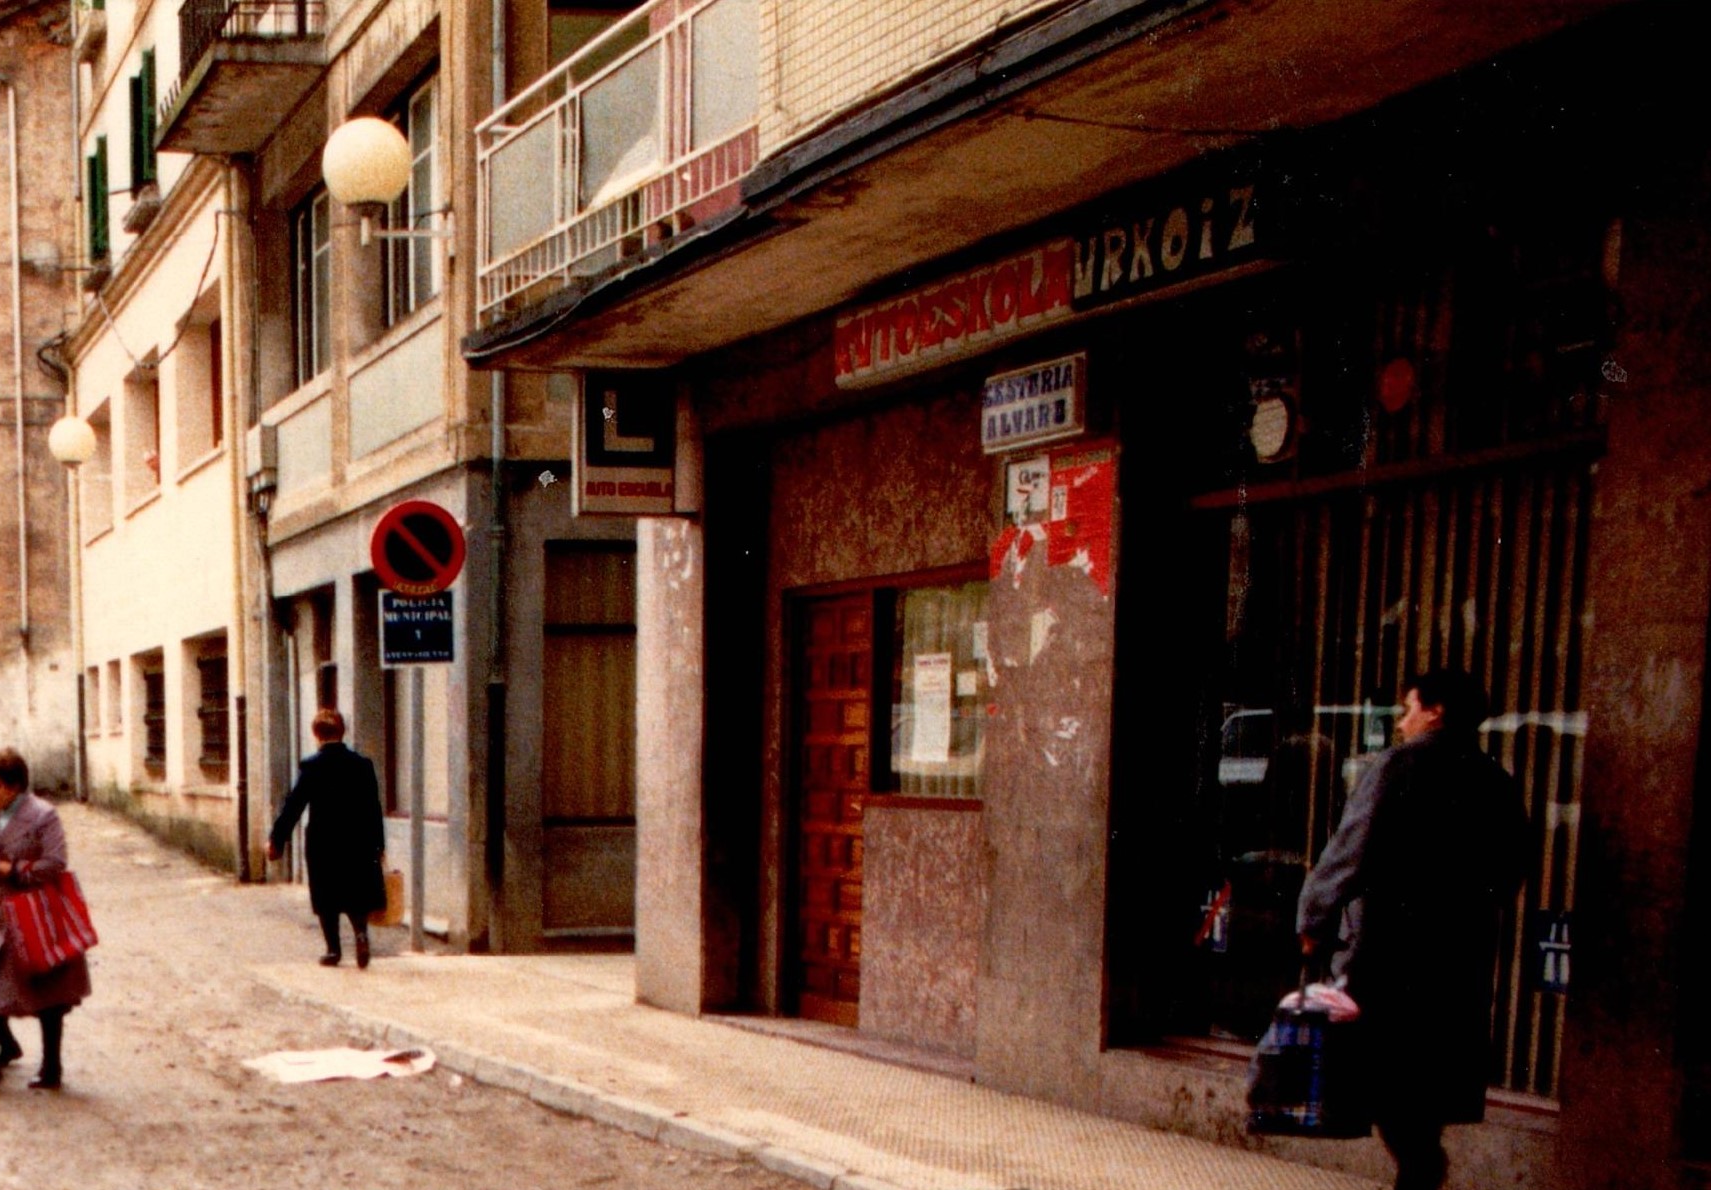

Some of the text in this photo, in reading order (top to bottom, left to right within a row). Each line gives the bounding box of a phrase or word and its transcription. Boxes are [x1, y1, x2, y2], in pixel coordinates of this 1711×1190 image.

[986, 400, 1066, 440] ALVARO
[586, 481, 673, 497] AUTO ESCUELA
[392, 597, 445, 608] POLICIA
[384, 610, 451, 622] MUNICIPAL
